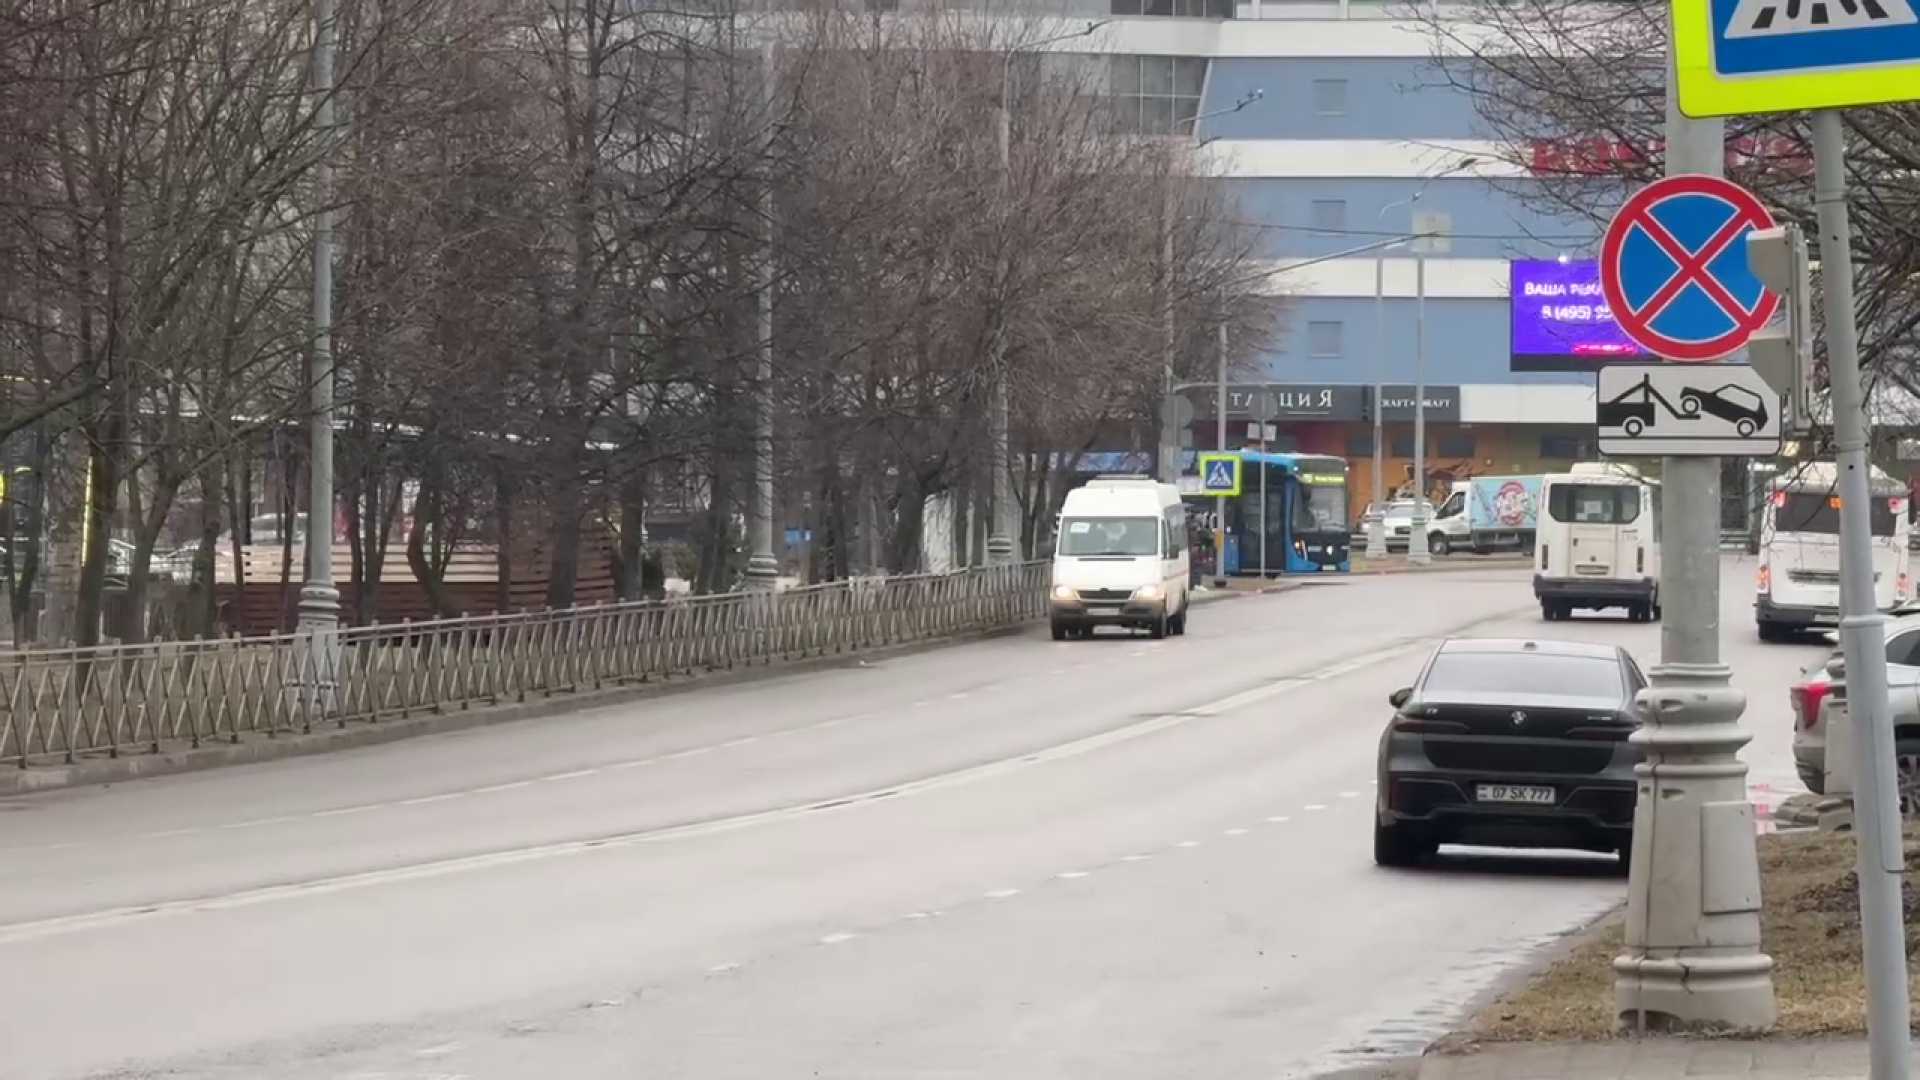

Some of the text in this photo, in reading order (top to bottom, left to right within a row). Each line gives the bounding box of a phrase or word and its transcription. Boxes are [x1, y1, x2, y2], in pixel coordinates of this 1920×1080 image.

[1524, 282, 1566, 297] ВАША
[1554, 305, 1591, 320] (495)
[1210, 389, 1333, 408] ТЦИЯ
[1381, 398, 1451, 408] RAFT RAFT
[1492, 786, 1552, 801] 07 SK 777
